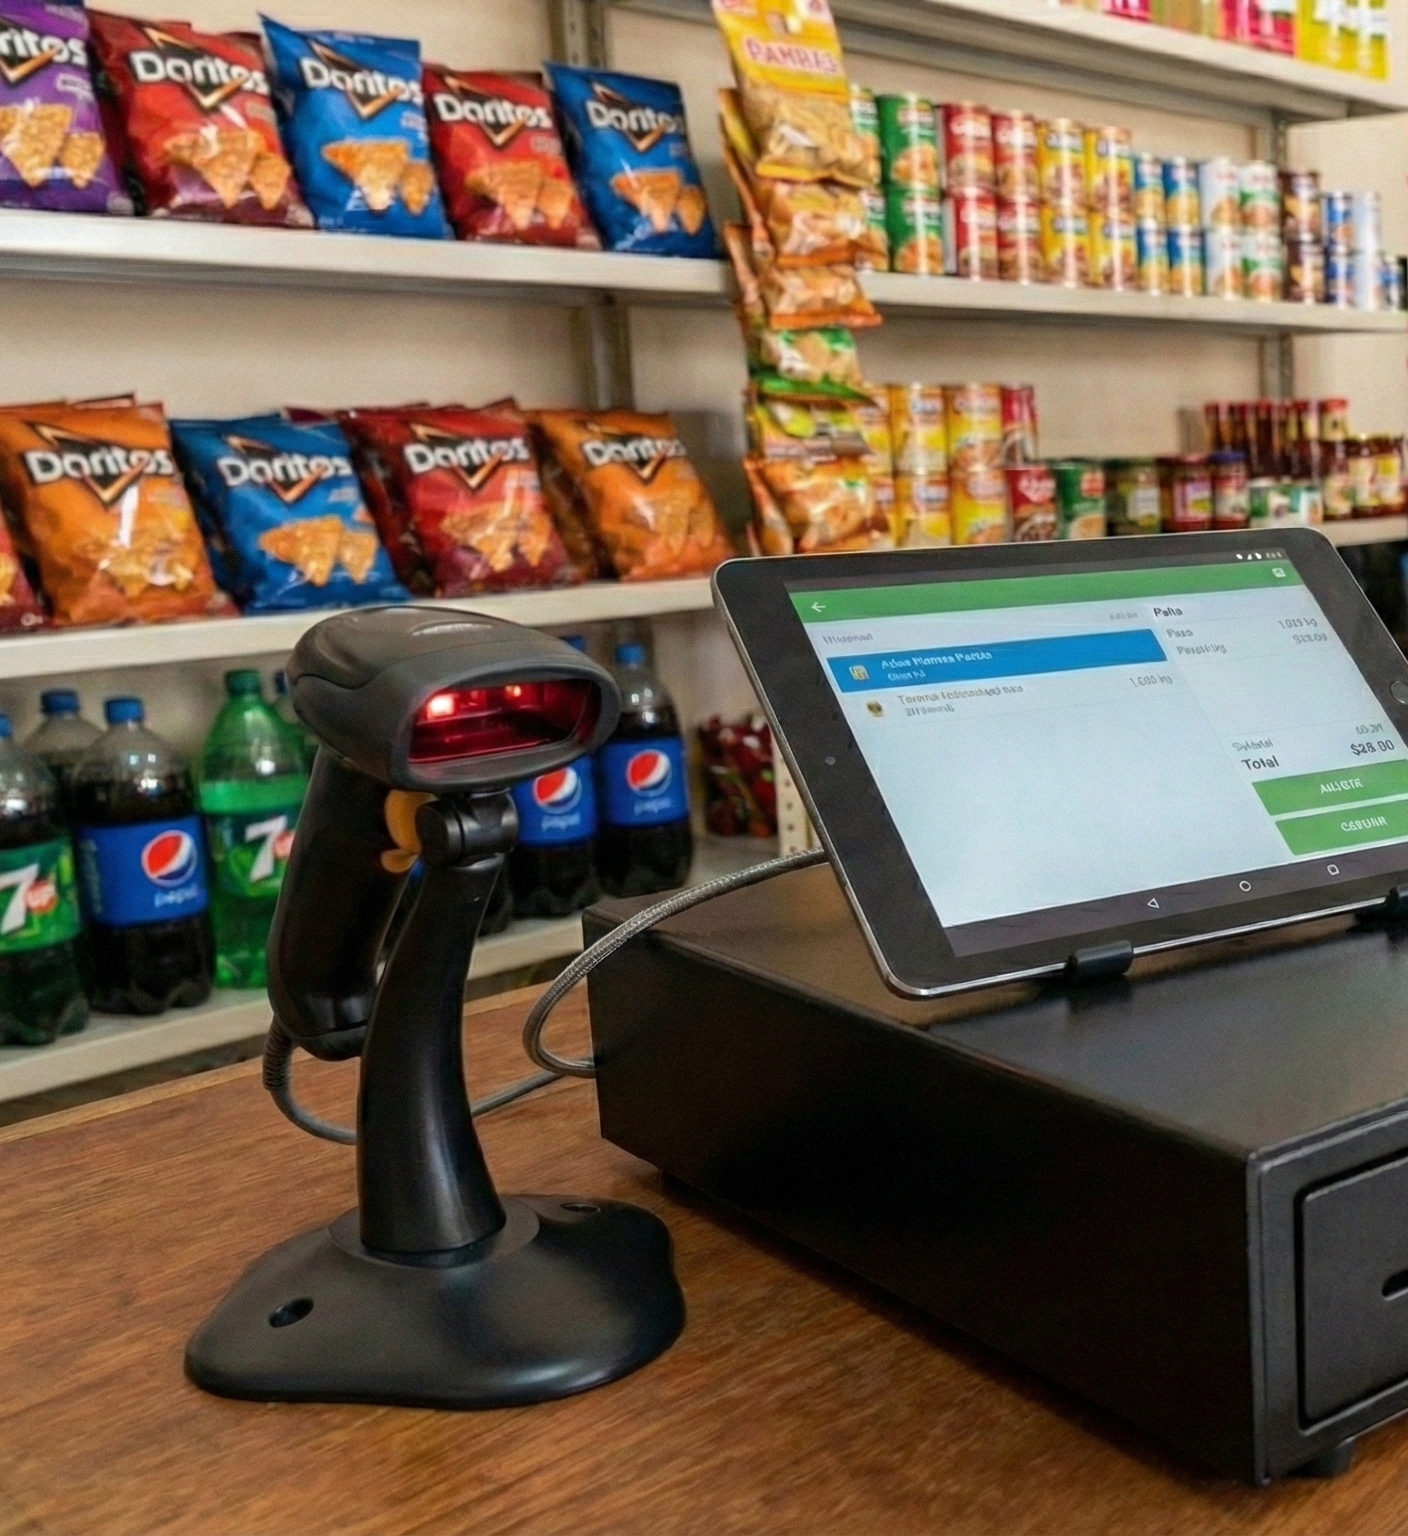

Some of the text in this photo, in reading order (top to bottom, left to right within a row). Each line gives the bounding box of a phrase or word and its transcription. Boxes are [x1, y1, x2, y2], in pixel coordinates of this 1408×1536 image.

[0, 27, 90, 67] ritos
[130, 51, 271, 96] Doritos
[300, 56, 424, 105] Doritos
[433, 92, 553, 130] Doritos
[585, 100, 685, 134] Doritos
[24, 447, 175, 484] Doritos
[217, 453, 353, 487] Doritos
[403, 437, 531, 474] Doritos
[583, 438, 687, 467] Doritos
[1240, 754, 1280, 771] Total
